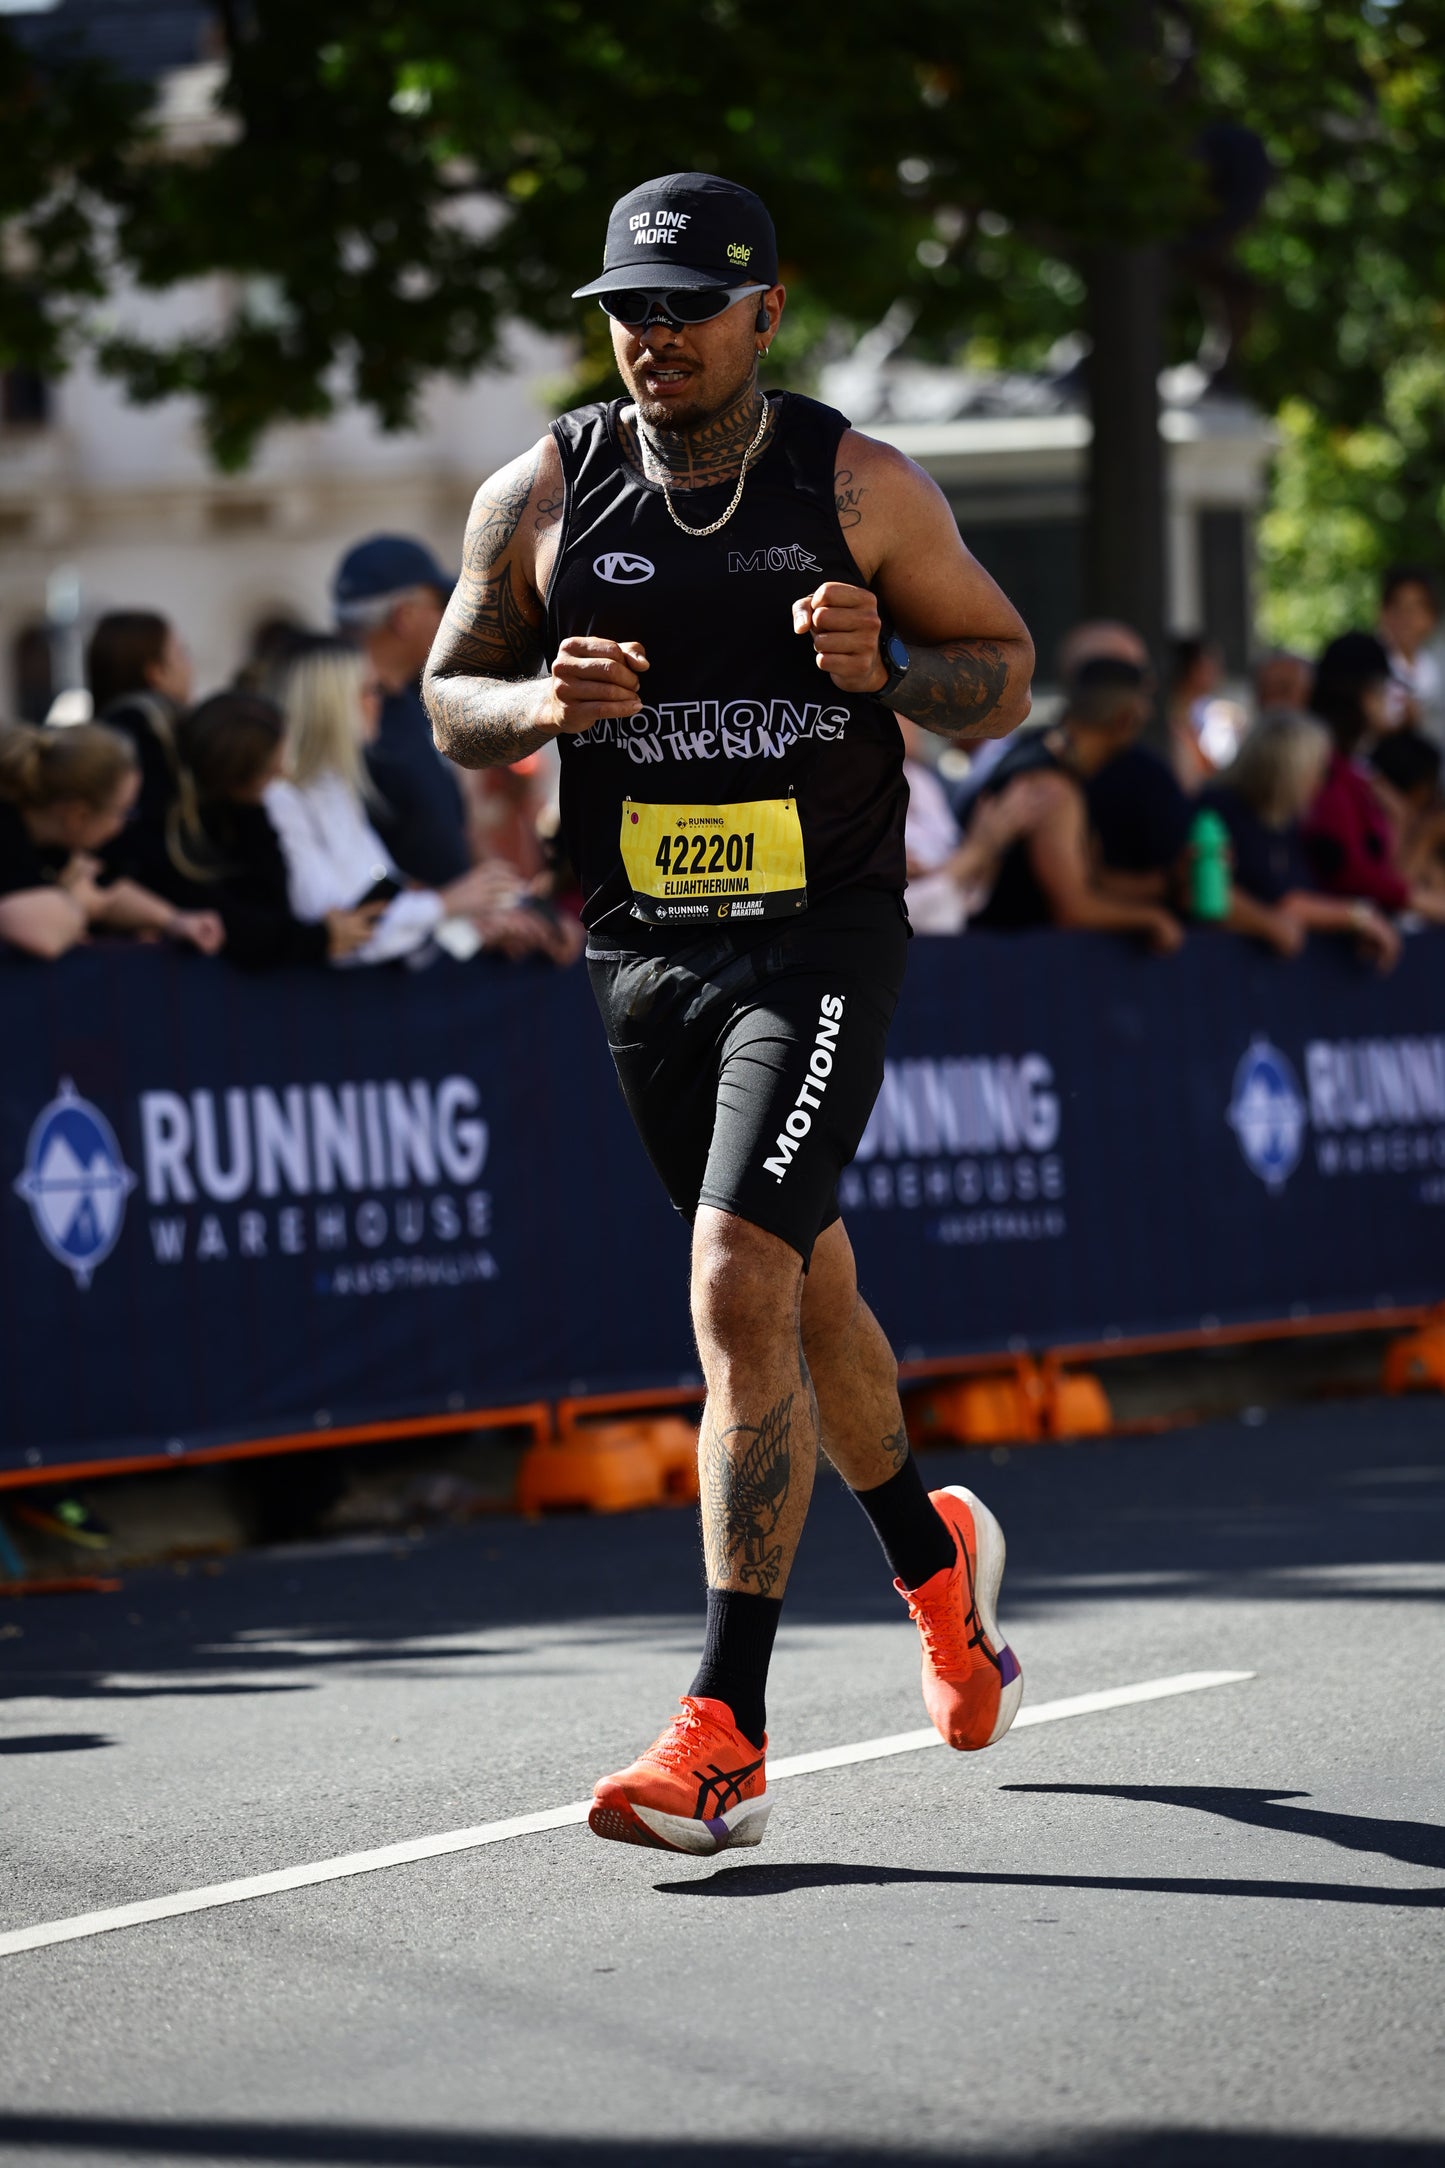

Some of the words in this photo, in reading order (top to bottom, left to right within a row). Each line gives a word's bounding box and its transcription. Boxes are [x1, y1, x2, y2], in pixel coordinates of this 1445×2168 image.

[629, 211, 650, 231] GO
[655, 210, 691, 230] ONE
[633, 228, 679, 245] MORE
[688, 817, 725, 826] RUNNING
[655, 832, 755, 876] 422201
[664, 877, 750, 896] ELIJAHTHERUNNA
[668, 905, 709, 915] RUNNING
[730, 907, 765, 917] MARATHON
[731, 900, 763, 909] BALLARAT
[139, 1074, 491, 1203] RUNNING
[149, 1190, 493, 1264] WAREHOUSE
